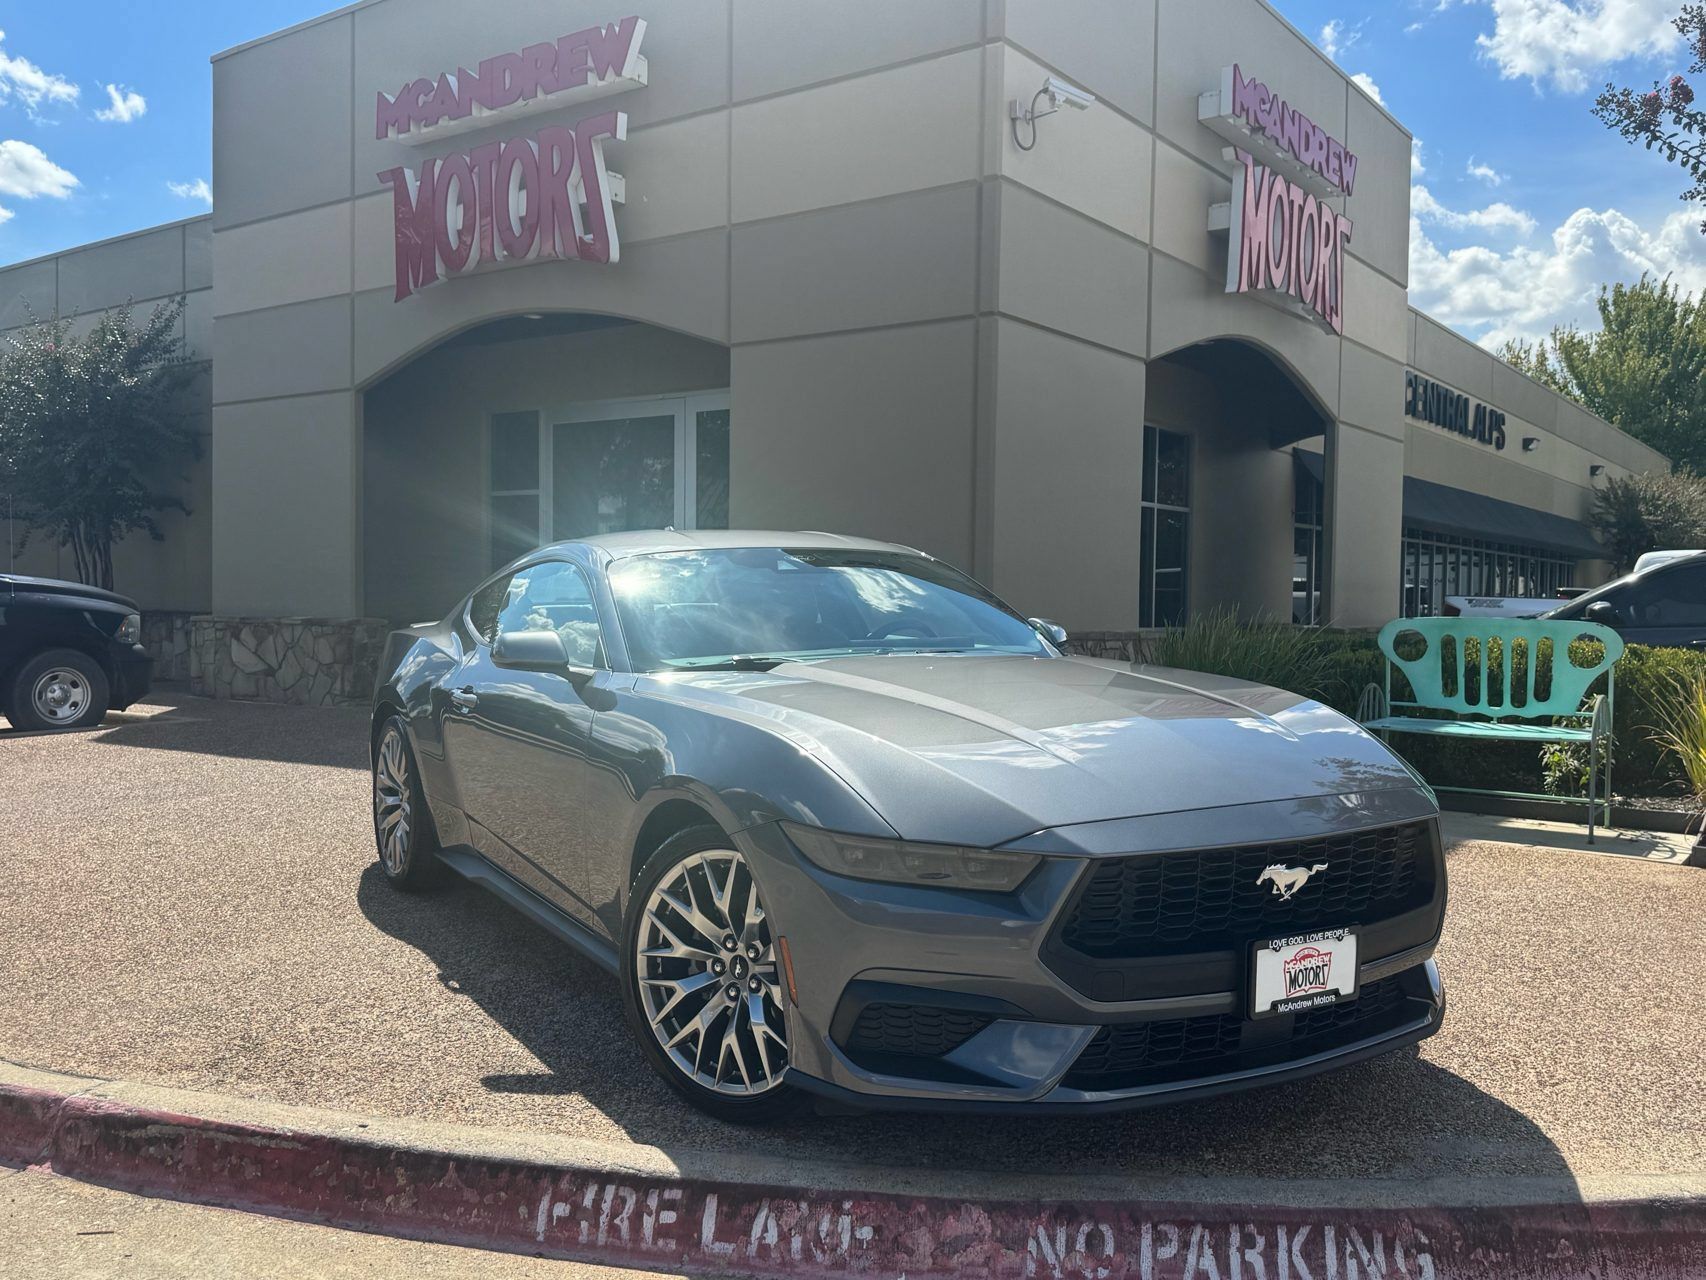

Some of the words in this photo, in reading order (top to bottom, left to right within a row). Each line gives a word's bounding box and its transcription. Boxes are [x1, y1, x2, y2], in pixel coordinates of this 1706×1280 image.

[376, 110, 624, 303] MOTORS
[1234, 146, 1353, 336] MOTORS
[1269, 939, 1287, 949] LOVE
[1288, 936, 1305, 946] GOD.
[1306, 933, 1324, 943] LOVE
[1286, 964, 1328, 993] MOTORS
[1278, 999, 1312, 1013] McAndrew
[1313, 994, 1336, 1006] Motors
